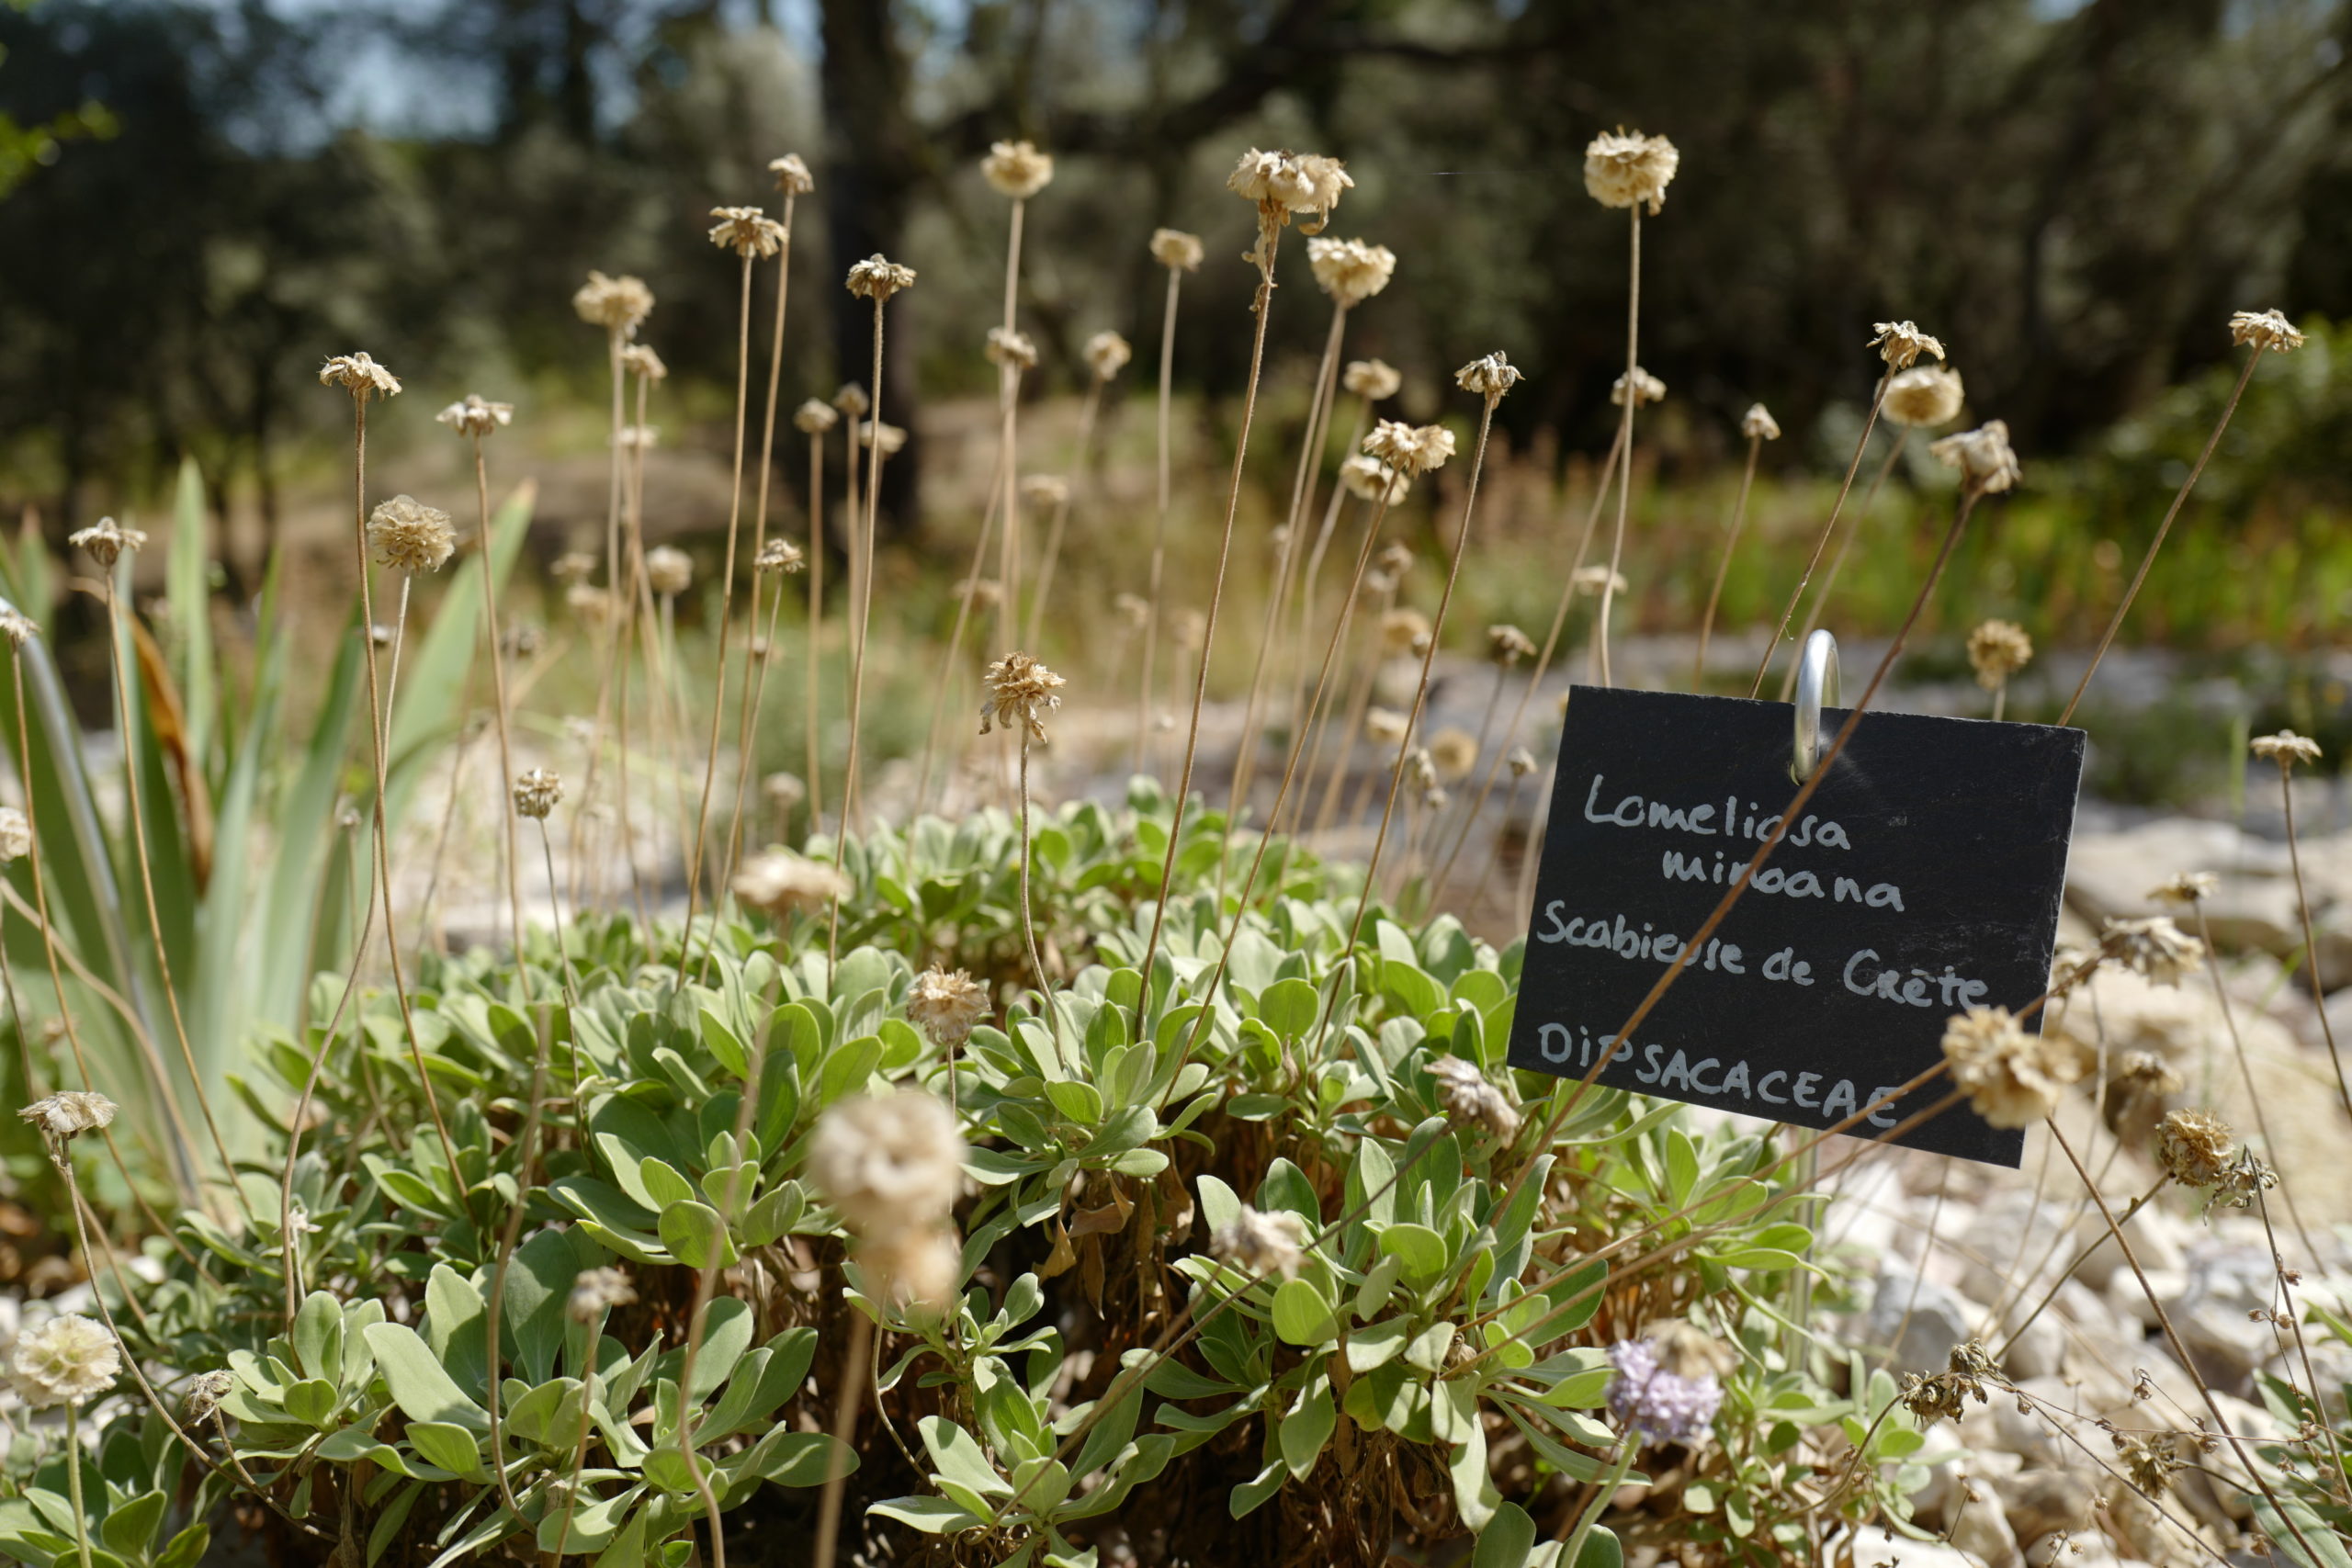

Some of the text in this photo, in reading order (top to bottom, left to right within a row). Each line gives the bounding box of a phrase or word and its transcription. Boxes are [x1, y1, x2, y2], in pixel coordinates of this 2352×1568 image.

[1584, 774, 1851, 851] Lomeliosa
[1662, 851, 1905, 912] minoana
[1536, 900, 1746, 975] Scabieuse
[1762, 947, 1815, 987] de
